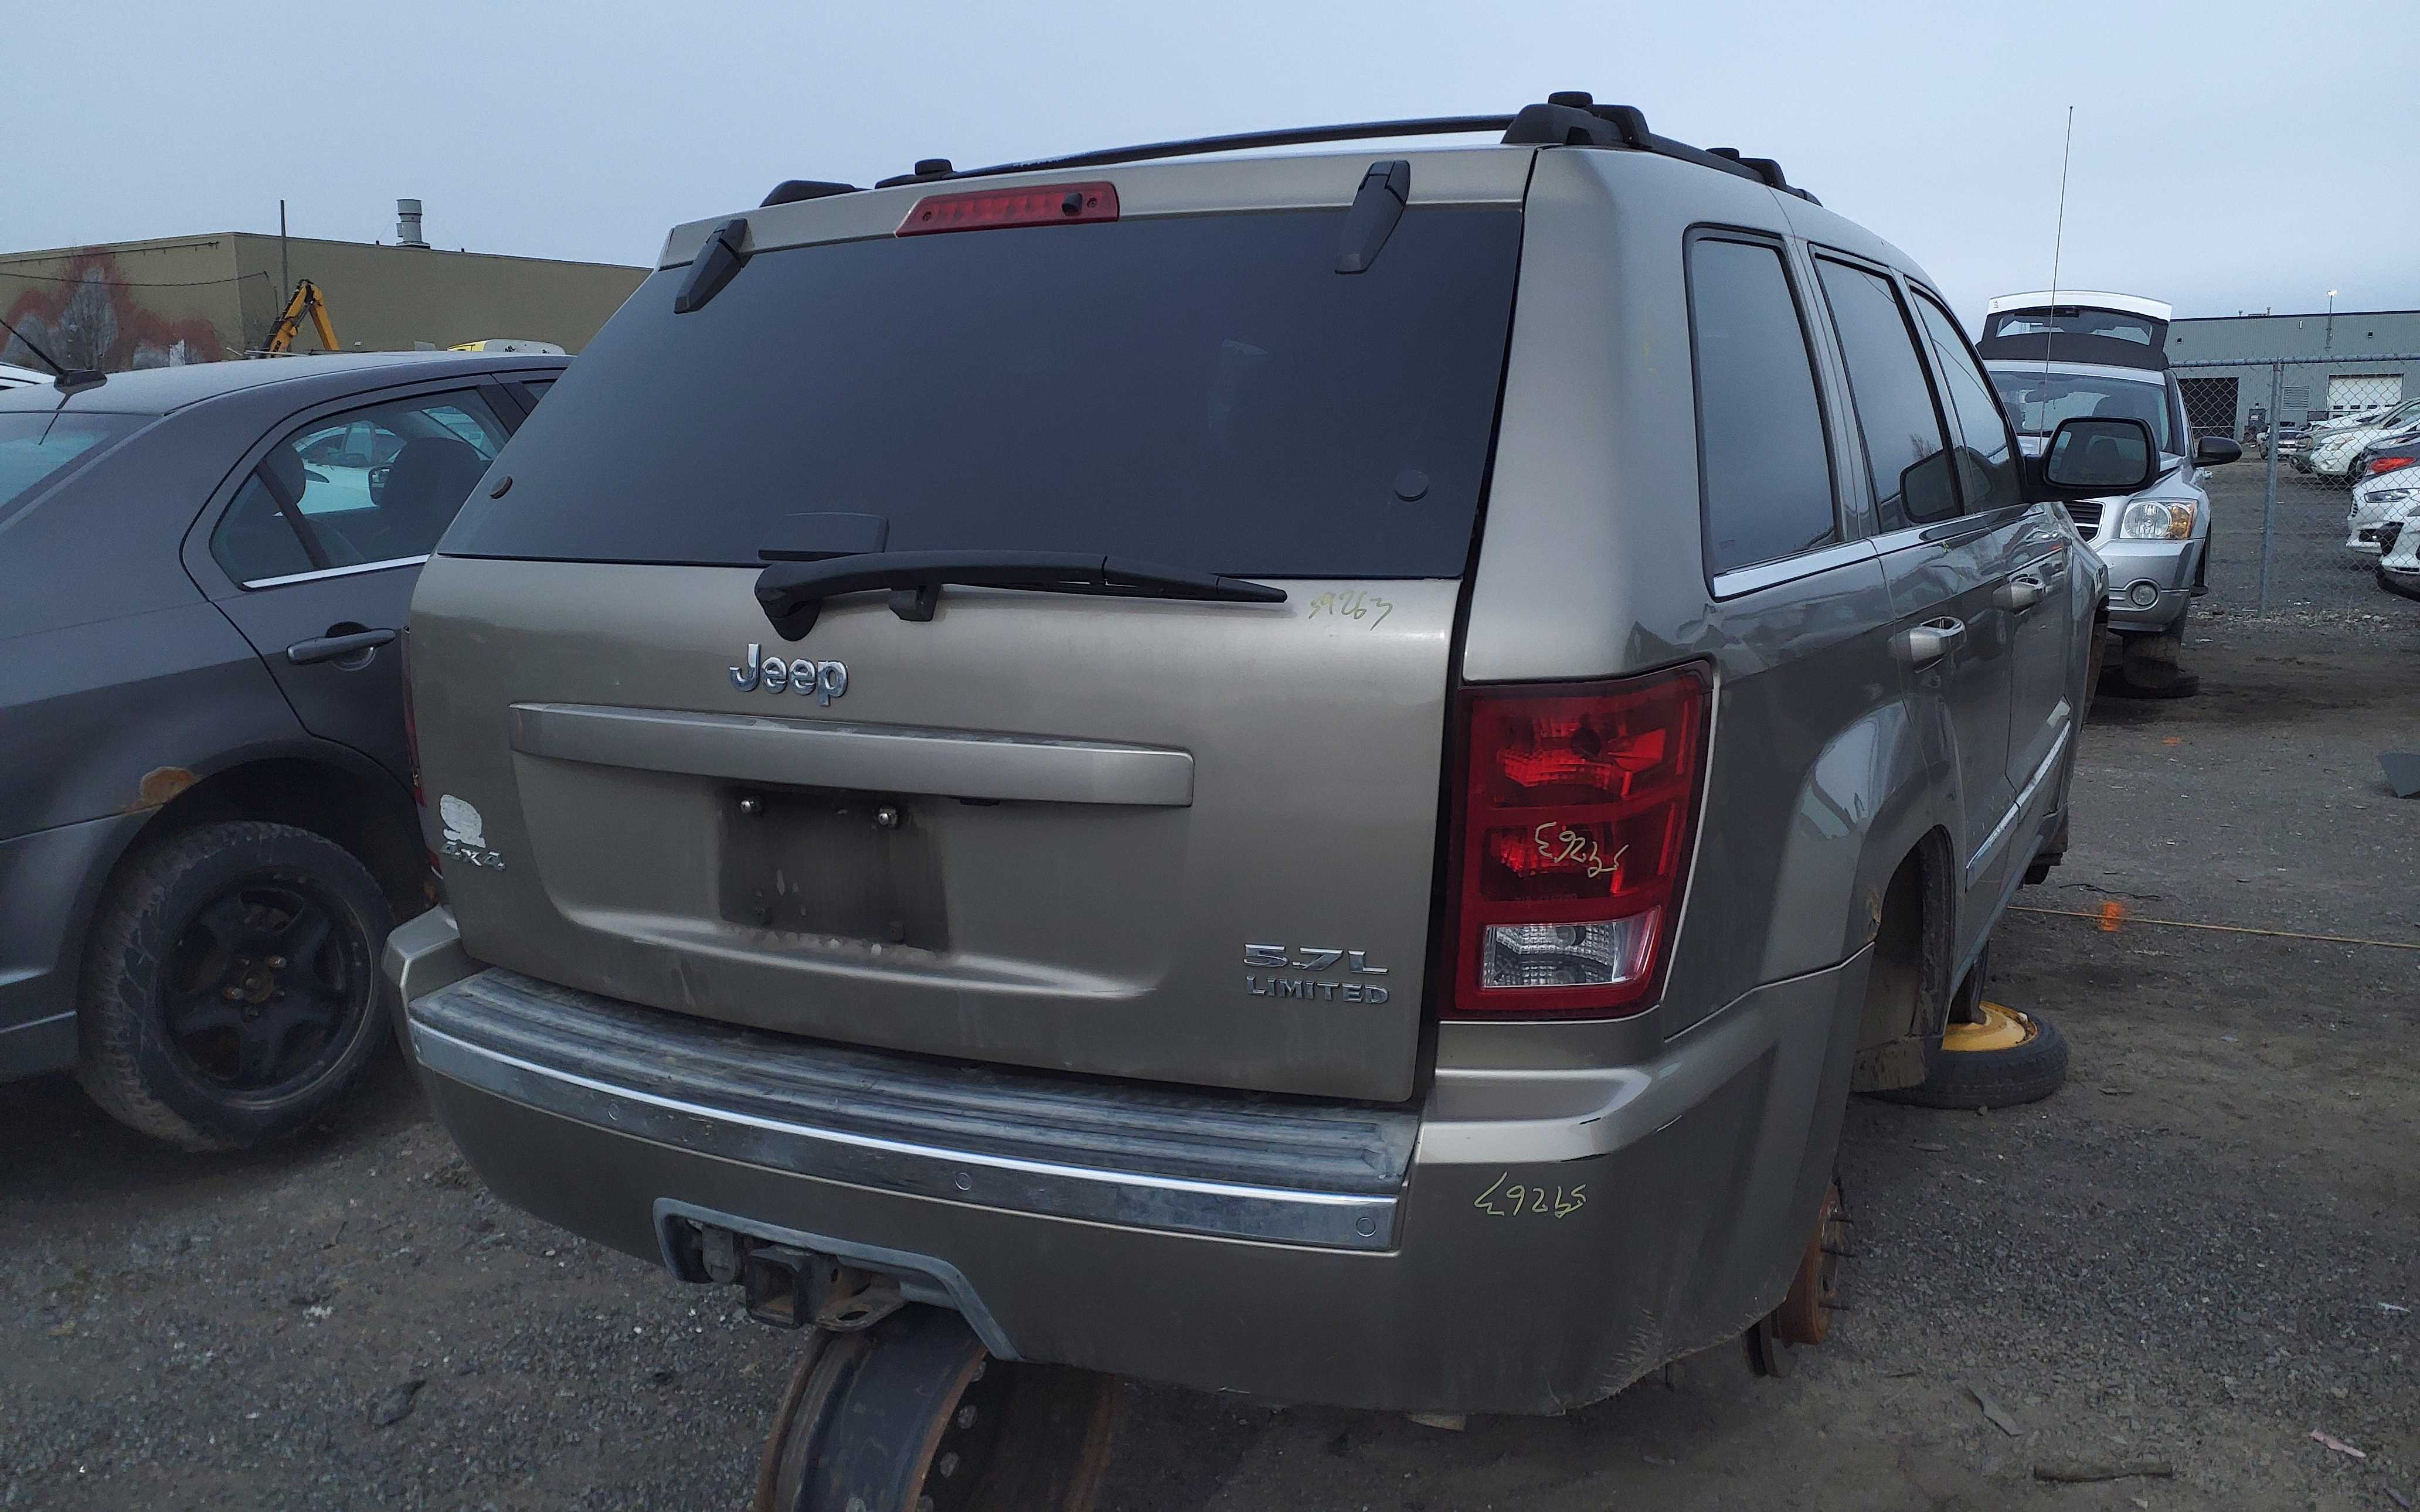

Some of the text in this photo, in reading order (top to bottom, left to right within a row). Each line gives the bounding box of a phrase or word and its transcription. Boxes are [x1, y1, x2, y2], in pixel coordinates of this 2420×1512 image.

[729, 642, 849, 707] Jeep
[1243, 943, 1389, 976] 5.7L
[1246, 975, 1389, 1004] LIMITED
